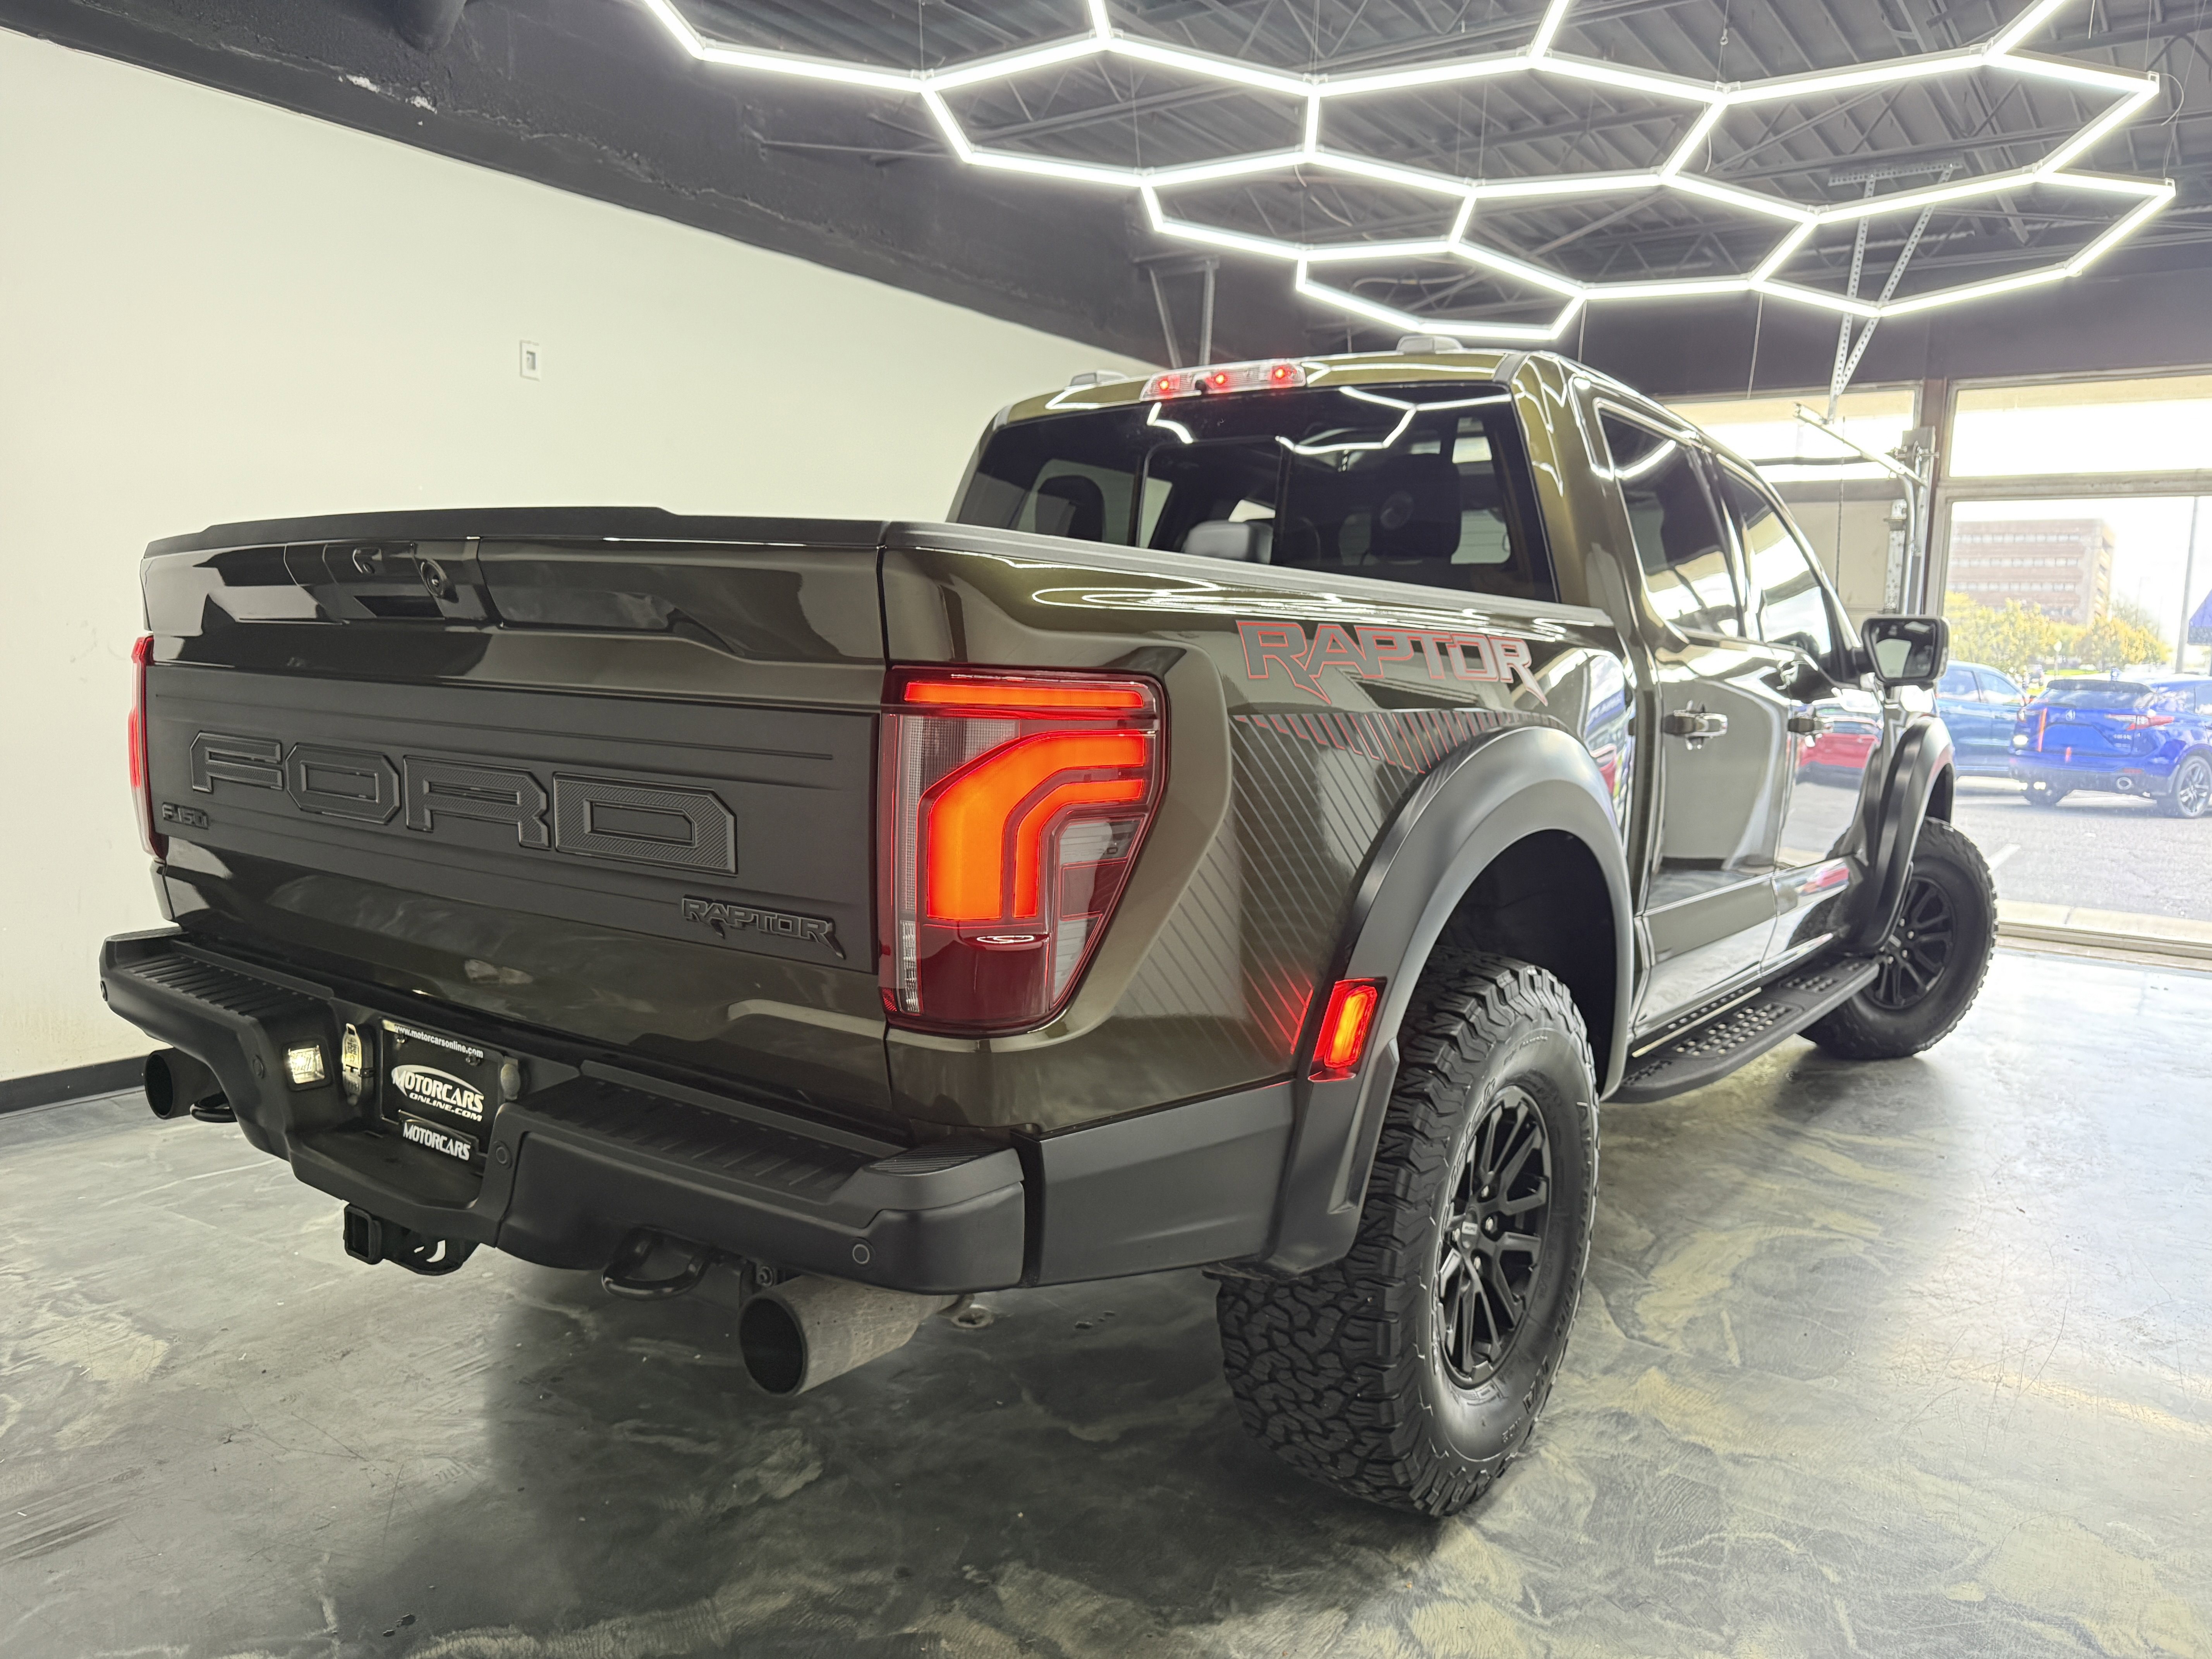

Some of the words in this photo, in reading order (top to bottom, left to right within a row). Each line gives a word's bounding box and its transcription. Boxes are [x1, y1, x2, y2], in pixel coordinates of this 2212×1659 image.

[1237, 620, 1548, 706] RAPTOR
[190, 731, 737, 877] FORD
[682, 896, 847, 960] RAPTOR
[395, 1026, 483, 1058] www.motorcarsonline.com
[393, 1068, 484, 1113] MOTORCARS
[409, 1092, 483, 1122] ONLINE.COM
[404, 1122, 471, 1161] MOTORCARS
